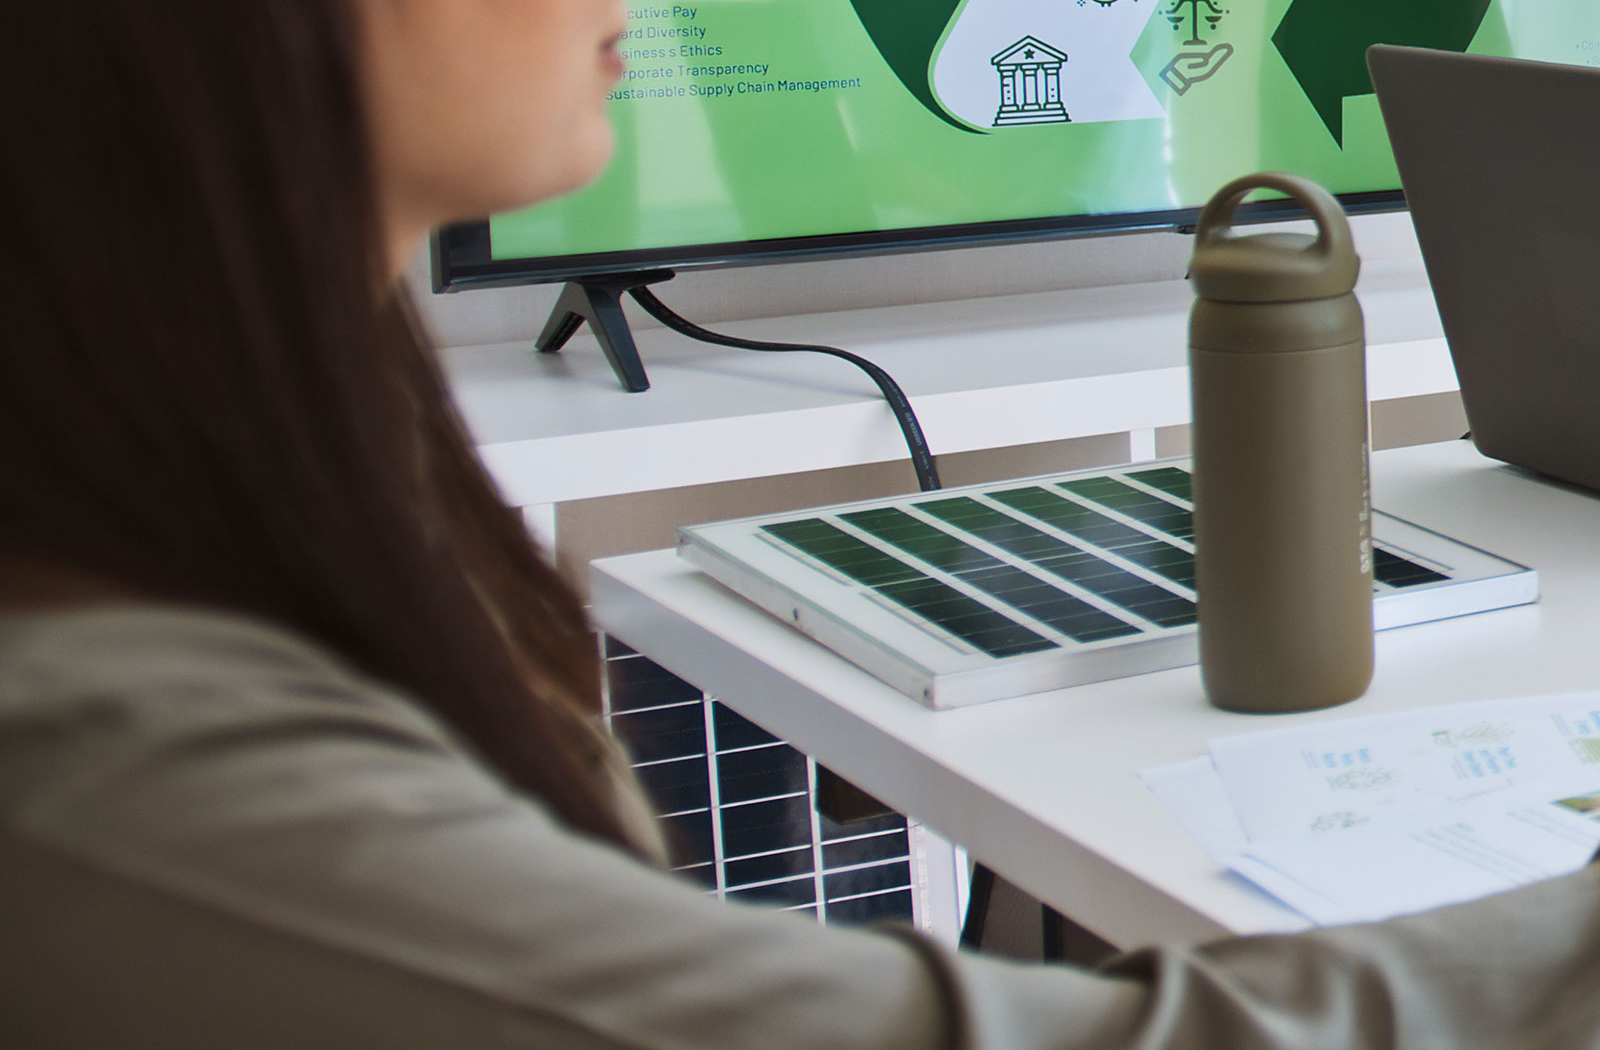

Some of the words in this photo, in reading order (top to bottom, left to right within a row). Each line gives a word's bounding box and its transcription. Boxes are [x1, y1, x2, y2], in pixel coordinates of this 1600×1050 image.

[627, 7, 669, 20] cutive
[672, 6, 697, 20] Pay
[647, 26, 707, 40] Diversity
[620, 48, 665, 60] siness
[668, 49, 677, 58] s
[680, 44, 723, 57] Ethics
[622, 66, 673, 81] rporate
[677, 62, 769, 77] Transparency
[606, 84, 685, 101] Sustainable
[689, 83, 735, 97] Supply
[737, 81, 775, 94] Chain
[777, 76, 862, 92] Management
